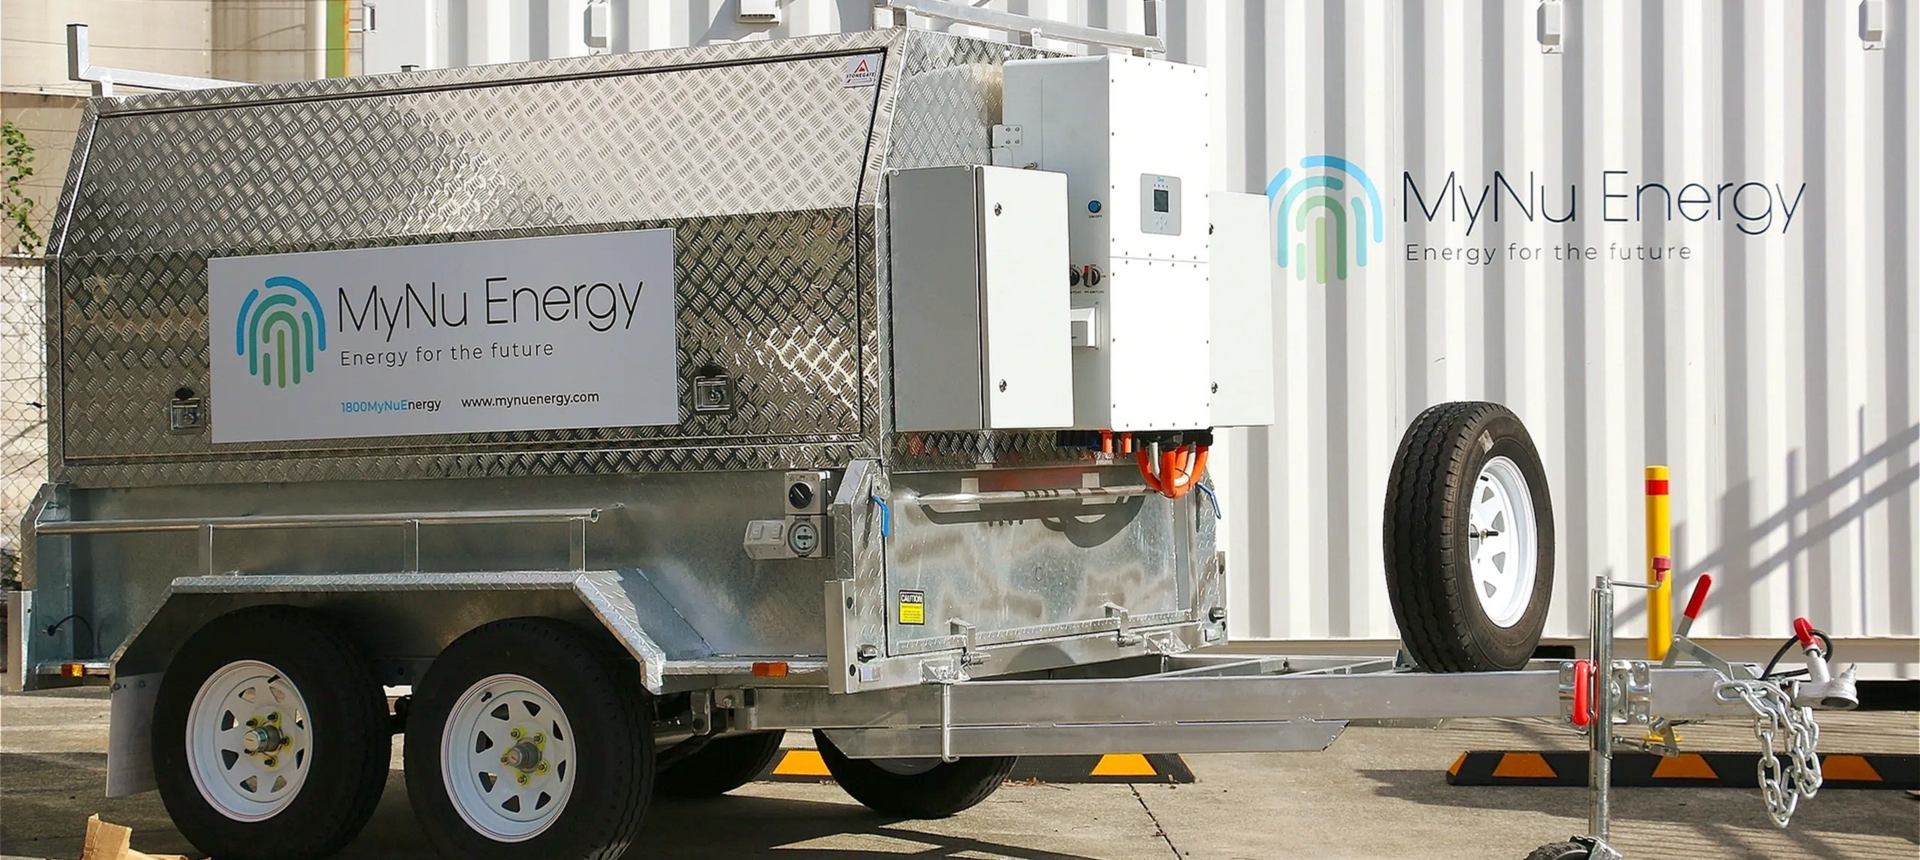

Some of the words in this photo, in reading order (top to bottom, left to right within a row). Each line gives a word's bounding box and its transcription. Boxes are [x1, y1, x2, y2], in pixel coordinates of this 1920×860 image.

[1403, 170, 1576, 237] MyNu
[1603, 170, 1806, 236] Energy
[1406, 243, 1497, 266] Energy
[1508, 242, 1542, 261] for
[1553, 242, 1598, 261] the
[1609, 243, 1692, 261] future
[338, 281, 468, 343] MyNu
[485, 276, 644, 332] Energy
[340, 350, 408, 368] Energy
[415, 345, 442, 362] for
[450, 344, 483, 360] the
[491, 341, 554, 359] future
[341, 399, 441, 414] 1800MyNuEnergy
[461, 391, 600, 409] www.mynuenergy.com
[901, 594, 923, 603] CAUTION
